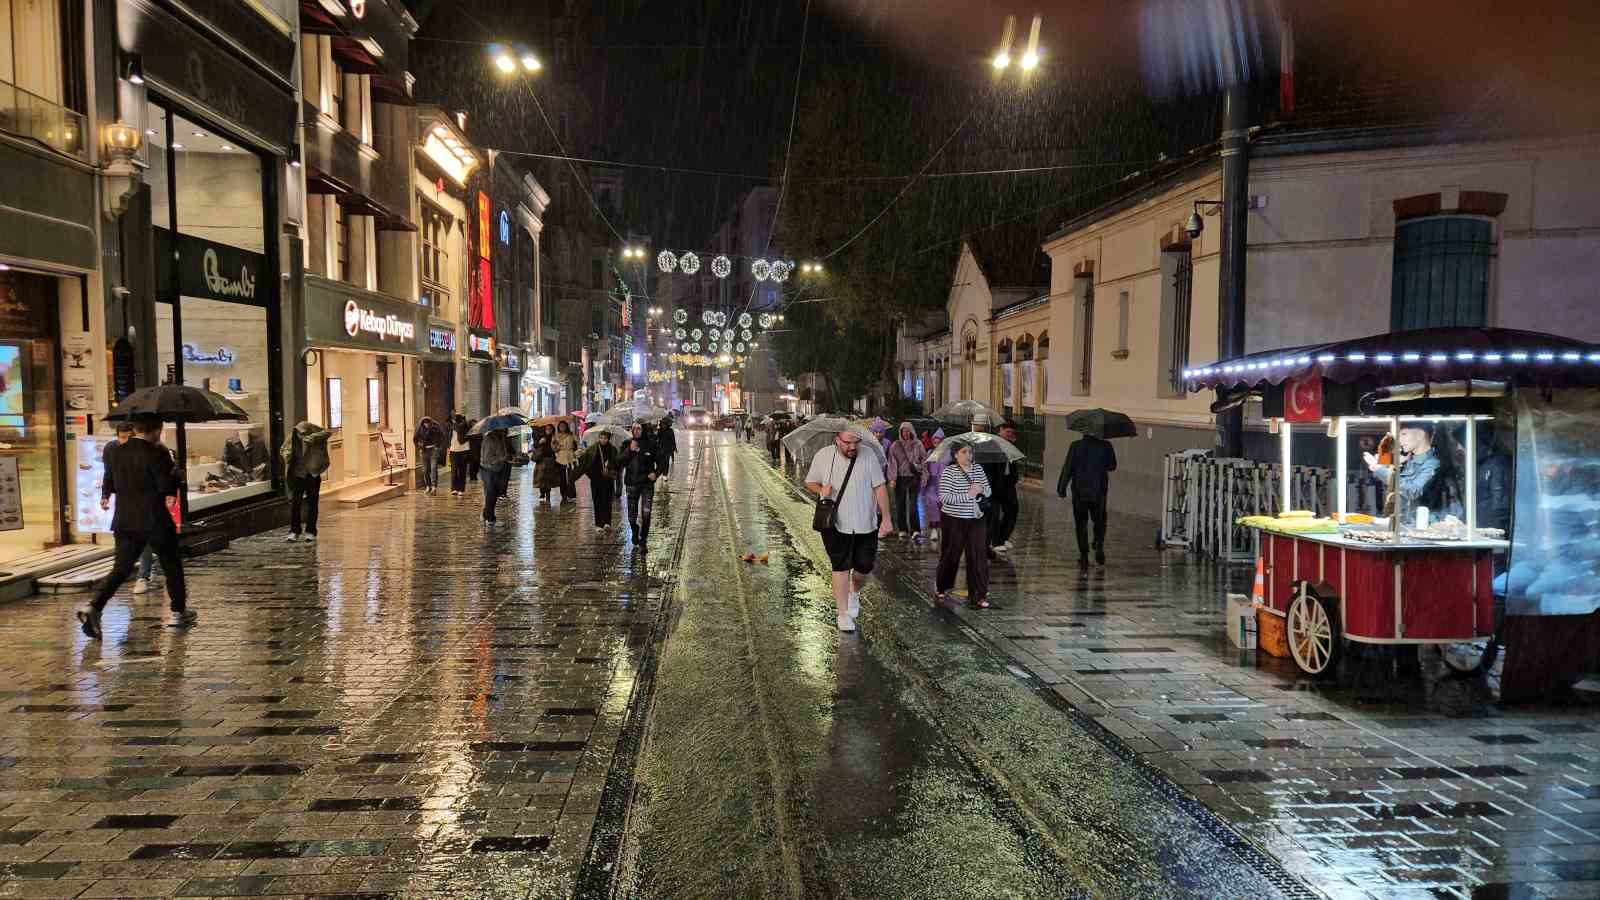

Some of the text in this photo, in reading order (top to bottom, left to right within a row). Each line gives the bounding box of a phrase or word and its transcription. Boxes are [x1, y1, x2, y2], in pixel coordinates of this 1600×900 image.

[203, 248, 255, 298] Bambi
[359, 309, 386, 340] Kebap
[386, 314, 414, 343] Dünyası
